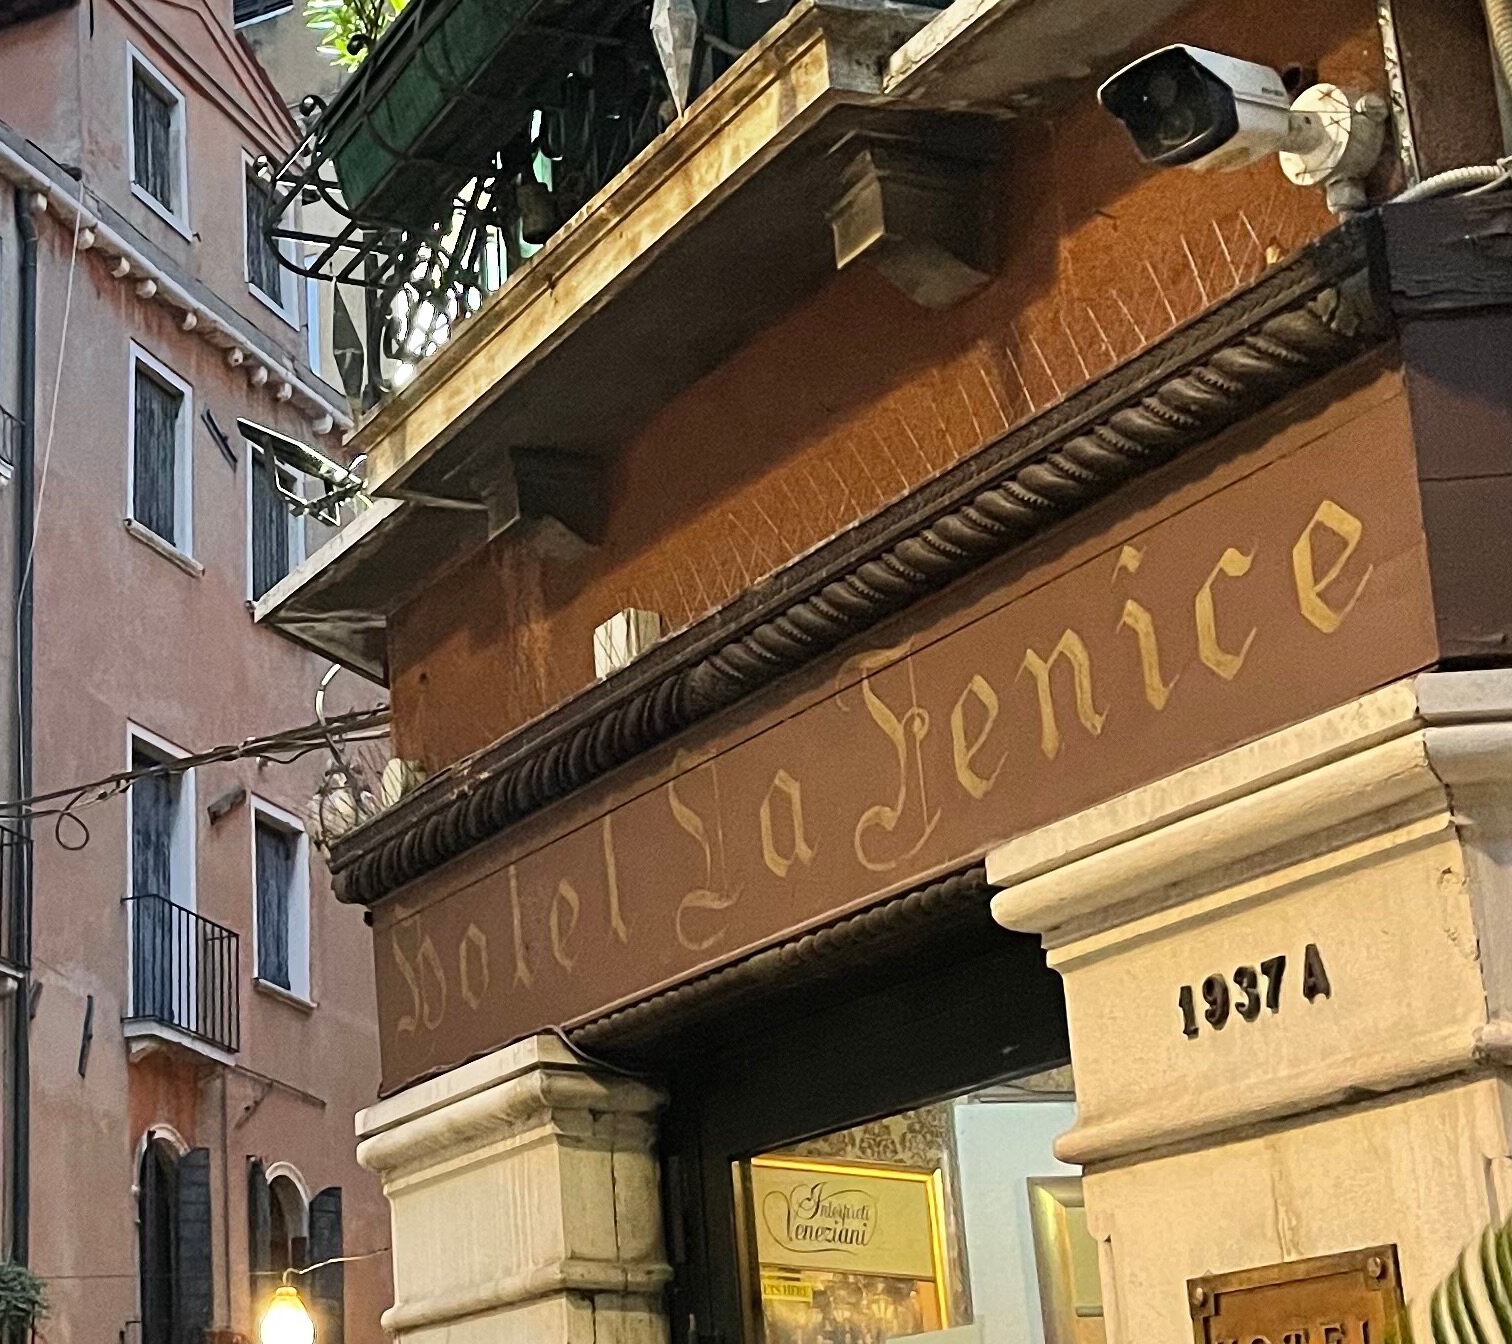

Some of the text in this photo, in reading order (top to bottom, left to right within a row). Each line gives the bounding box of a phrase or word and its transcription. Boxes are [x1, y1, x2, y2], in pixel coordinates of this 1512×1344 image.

[835, 500, 1374, 872] Fenice
[1178, 942, 1332, 1041] 1937 A
[773, 1196, 871, 1249] Veneziani
